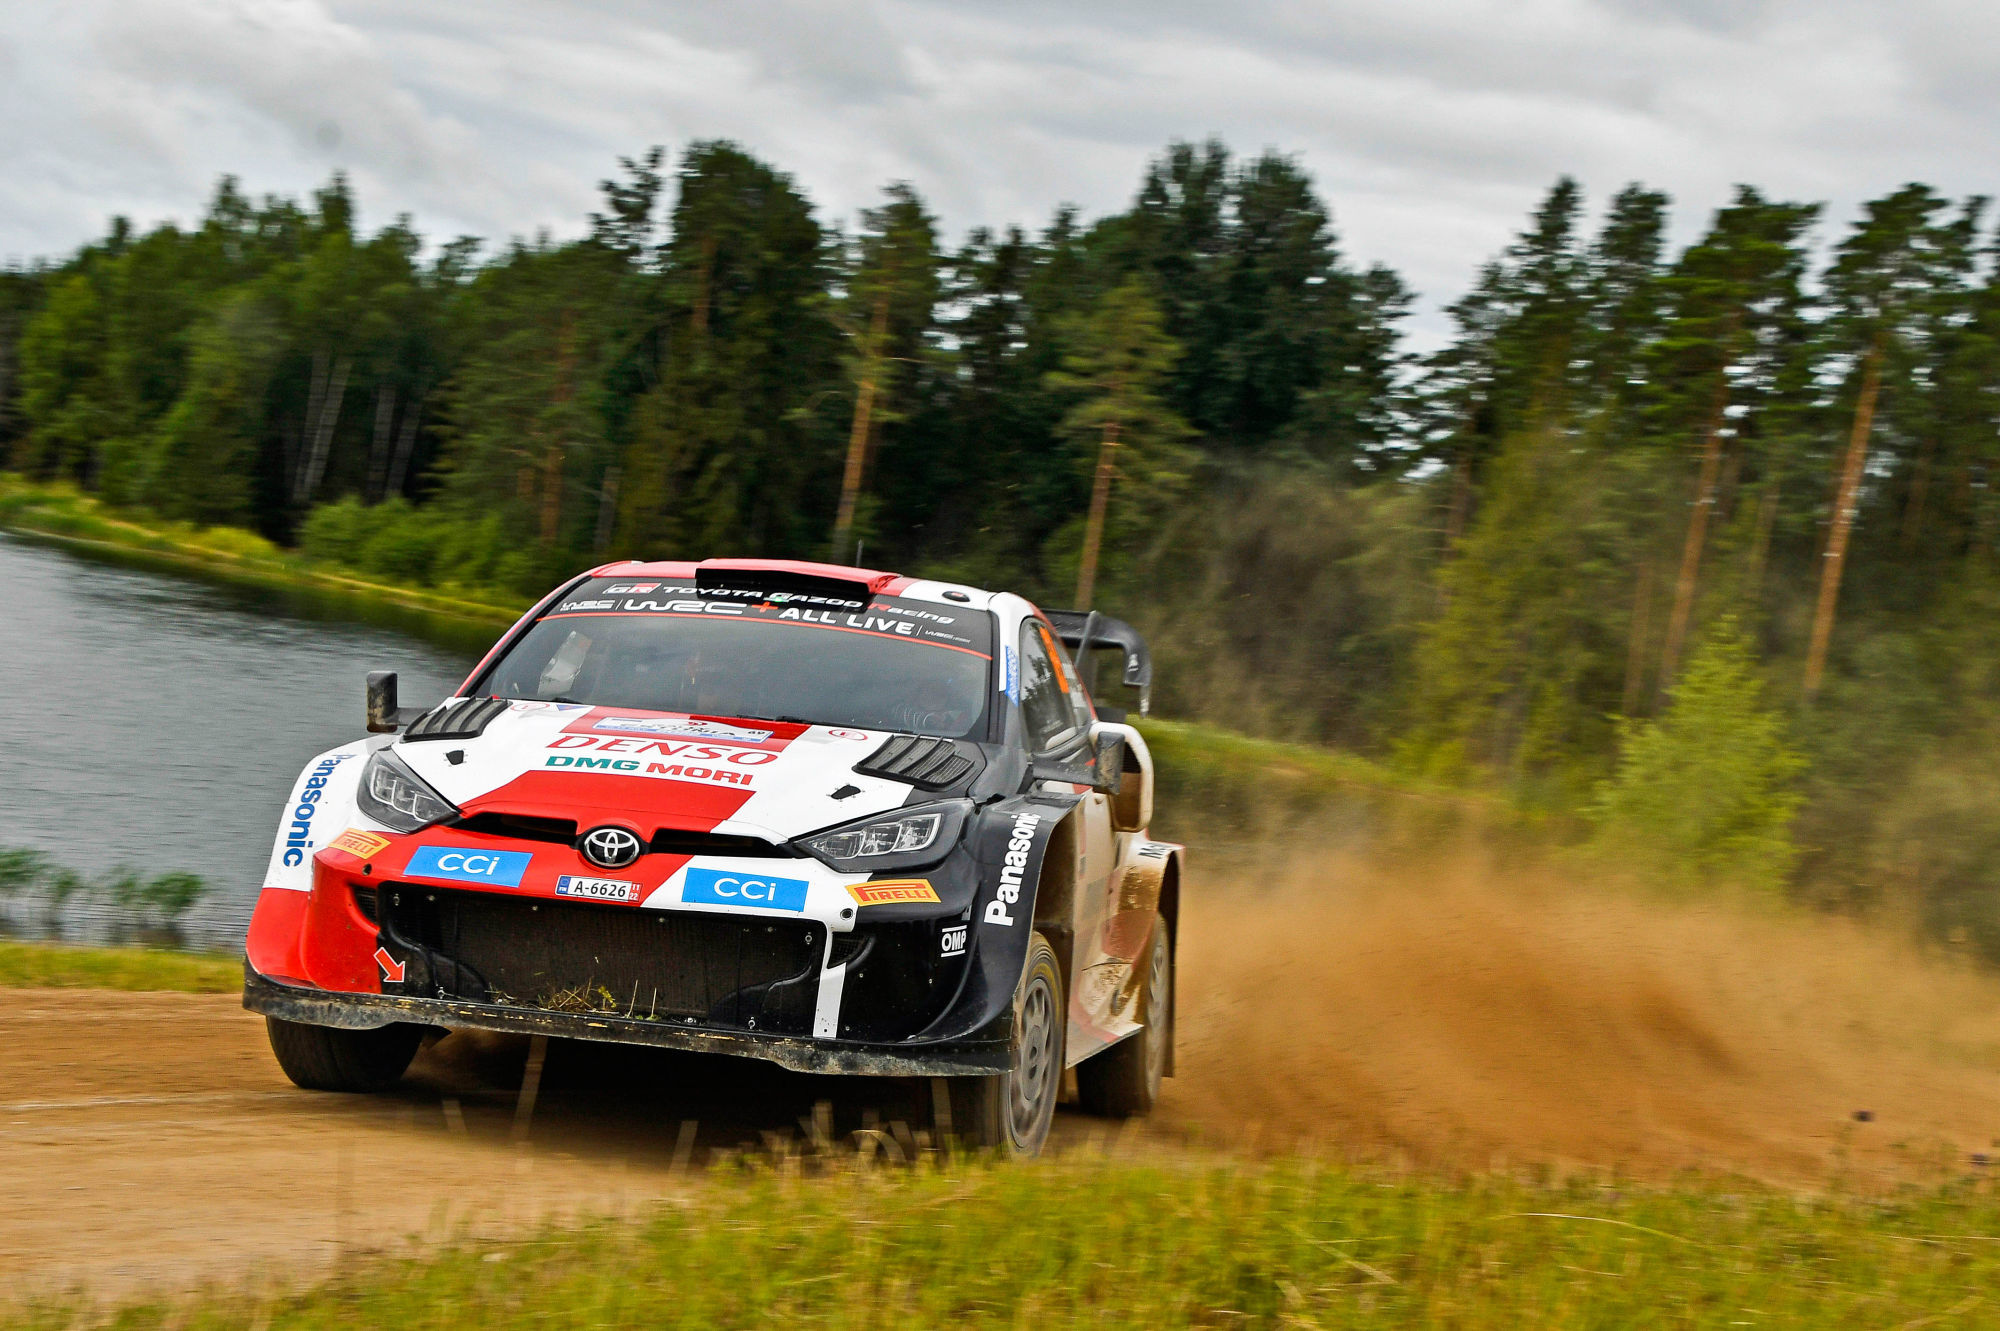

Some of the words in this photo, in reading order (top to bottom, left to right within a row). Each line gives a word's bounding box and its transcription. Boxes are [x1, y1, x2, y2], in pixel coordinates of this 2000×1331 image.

[663, 587, 763, 598] TOYOTA
[763, 592, 864, 608] GAZOO
[868, 603, 956, 624] Racing
[779, 607, 837, 624] ALL
[846, 614, 915, 635] LIVE
[546, 735, 778, 766] DENSO
[545, 755, 640, 771] DMG
[645, 762, 753, 786] MORI
[283, 754, 357, 867] Panasonic
[984, 812, 1041, 927] Panasonic
[574, 881, 626, 897] A-6626
[853, 883, 932, 902] PIRELLI
[941, 930, 967, 951] OMP
